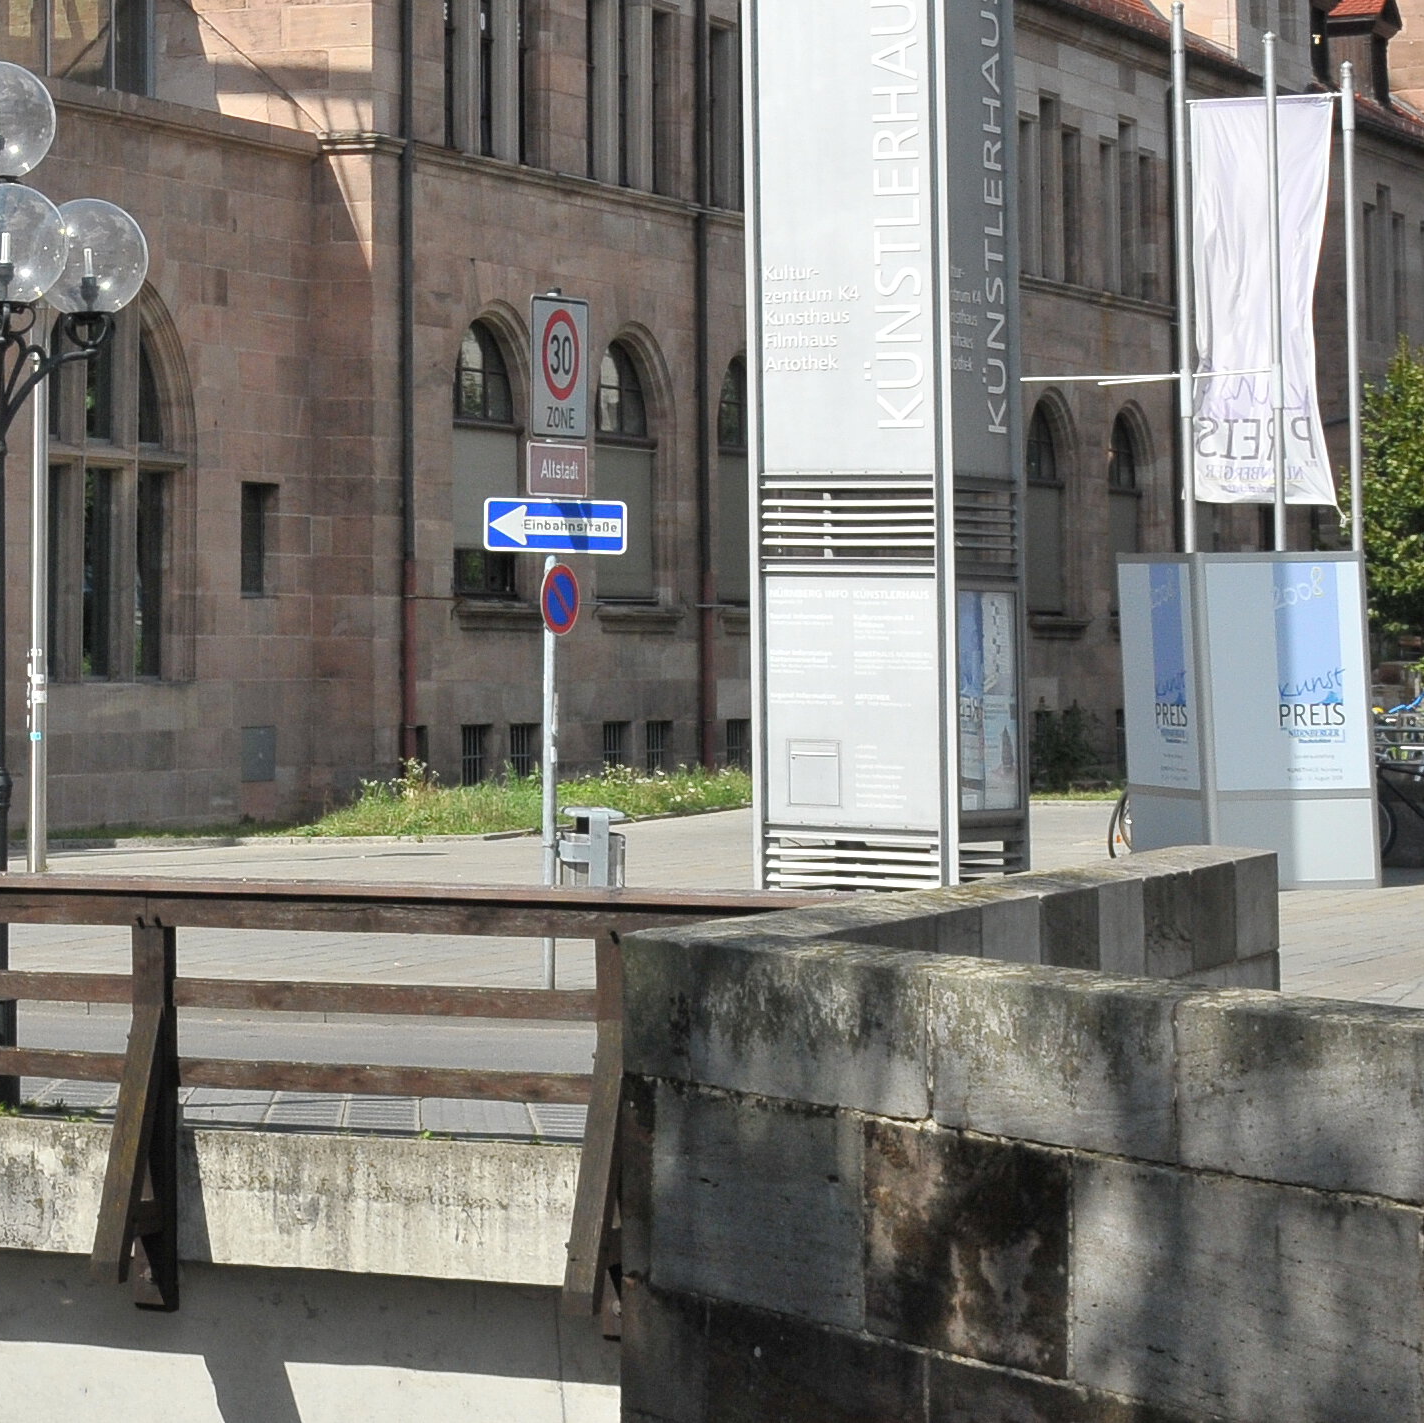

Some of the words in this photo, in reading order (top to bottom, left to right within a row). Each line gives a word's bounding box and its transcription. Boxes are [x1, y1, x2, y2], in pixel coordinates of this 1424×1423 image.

[763, 264, 820, 282] Kultur-
[764, 289, 833, 305] zentrum
[838, 285, 862, 302] K4
[764, 308, 850, 326] Kunsthaus
[764, 330, 838, 349] Filmhaus
[550, 334, 572, 376] 30
[764, 353, 839, 373] Artothek
[546, 406, 575, 429] ZONE
[540, 459, 579, 480] Altstadt
[523, 518, 618, 533] Einbahnstraße
[853, 588, 930, 600] KÜNSTLERHAUS
[1279, 669, 1345, 700] kunst
[1156, 703, 1188, 727] PREIS
[1279, 703, 1345, 727] PREIS
